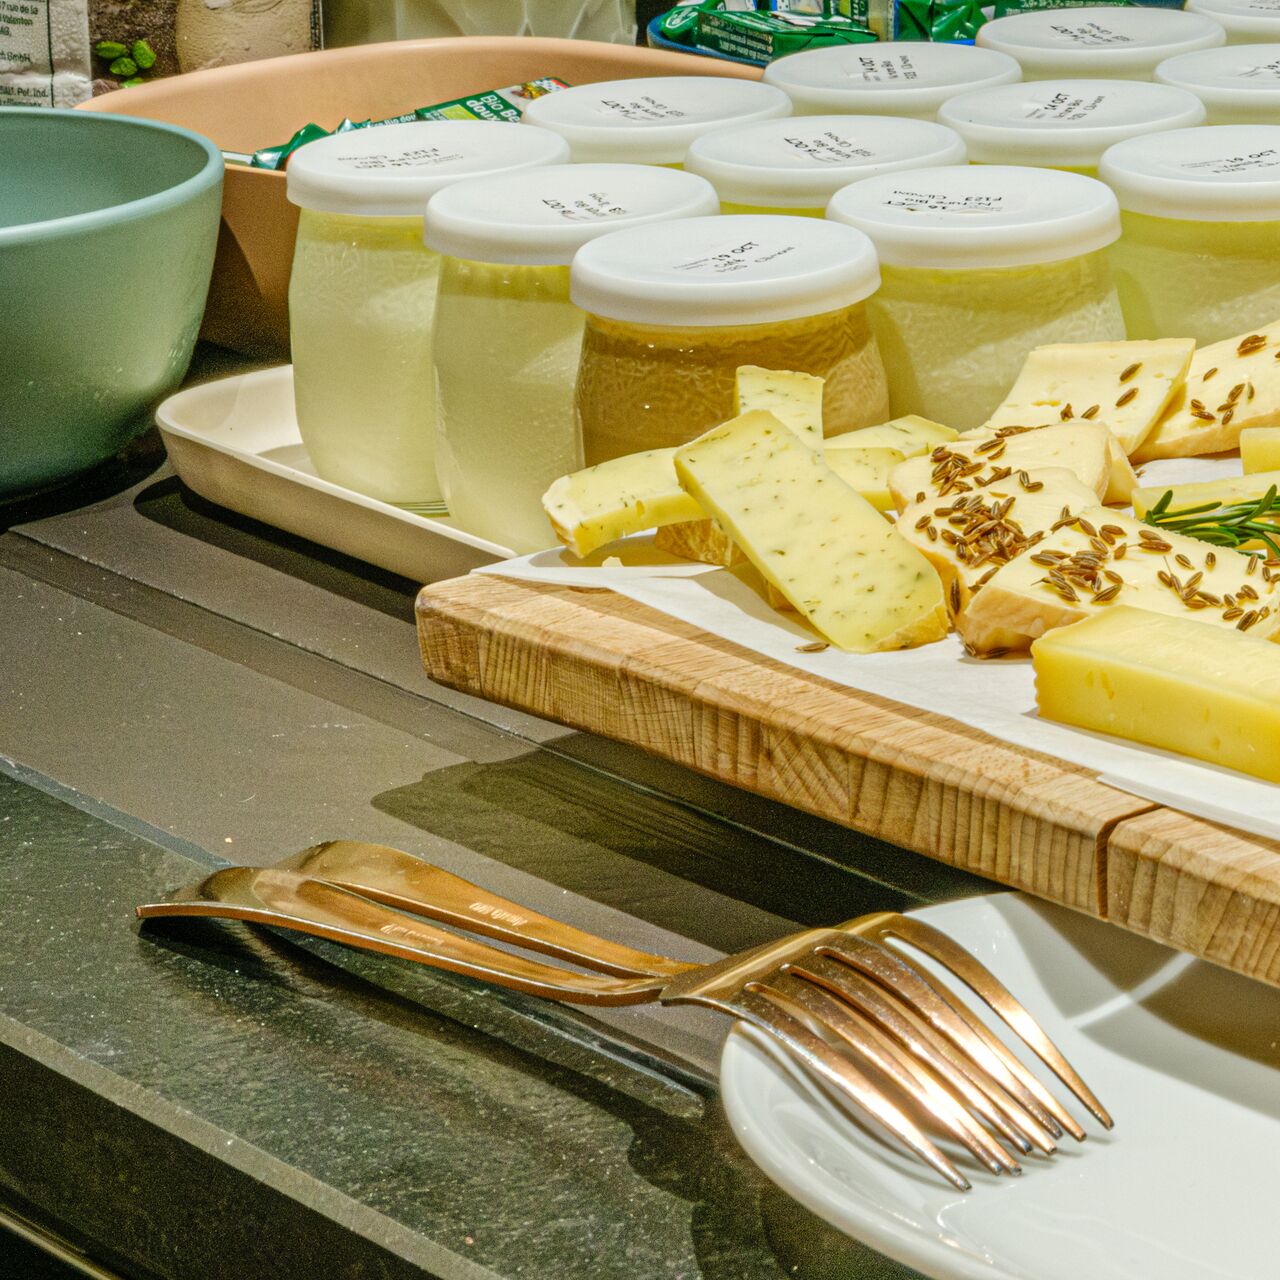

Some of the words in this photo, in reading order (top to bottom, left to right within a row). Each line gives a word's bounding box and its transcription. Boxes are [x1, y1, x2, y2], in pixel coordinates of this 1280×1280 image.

[480, 94, 504, 111] Bio
[1052, 93, 1070, 104] OCT
[784, 138, 808, 148] OCT
[1248, 149, 1277, 158] OCT
[542, 200, 565, 209] OCT
[731, 242, 759, 253] OCT
